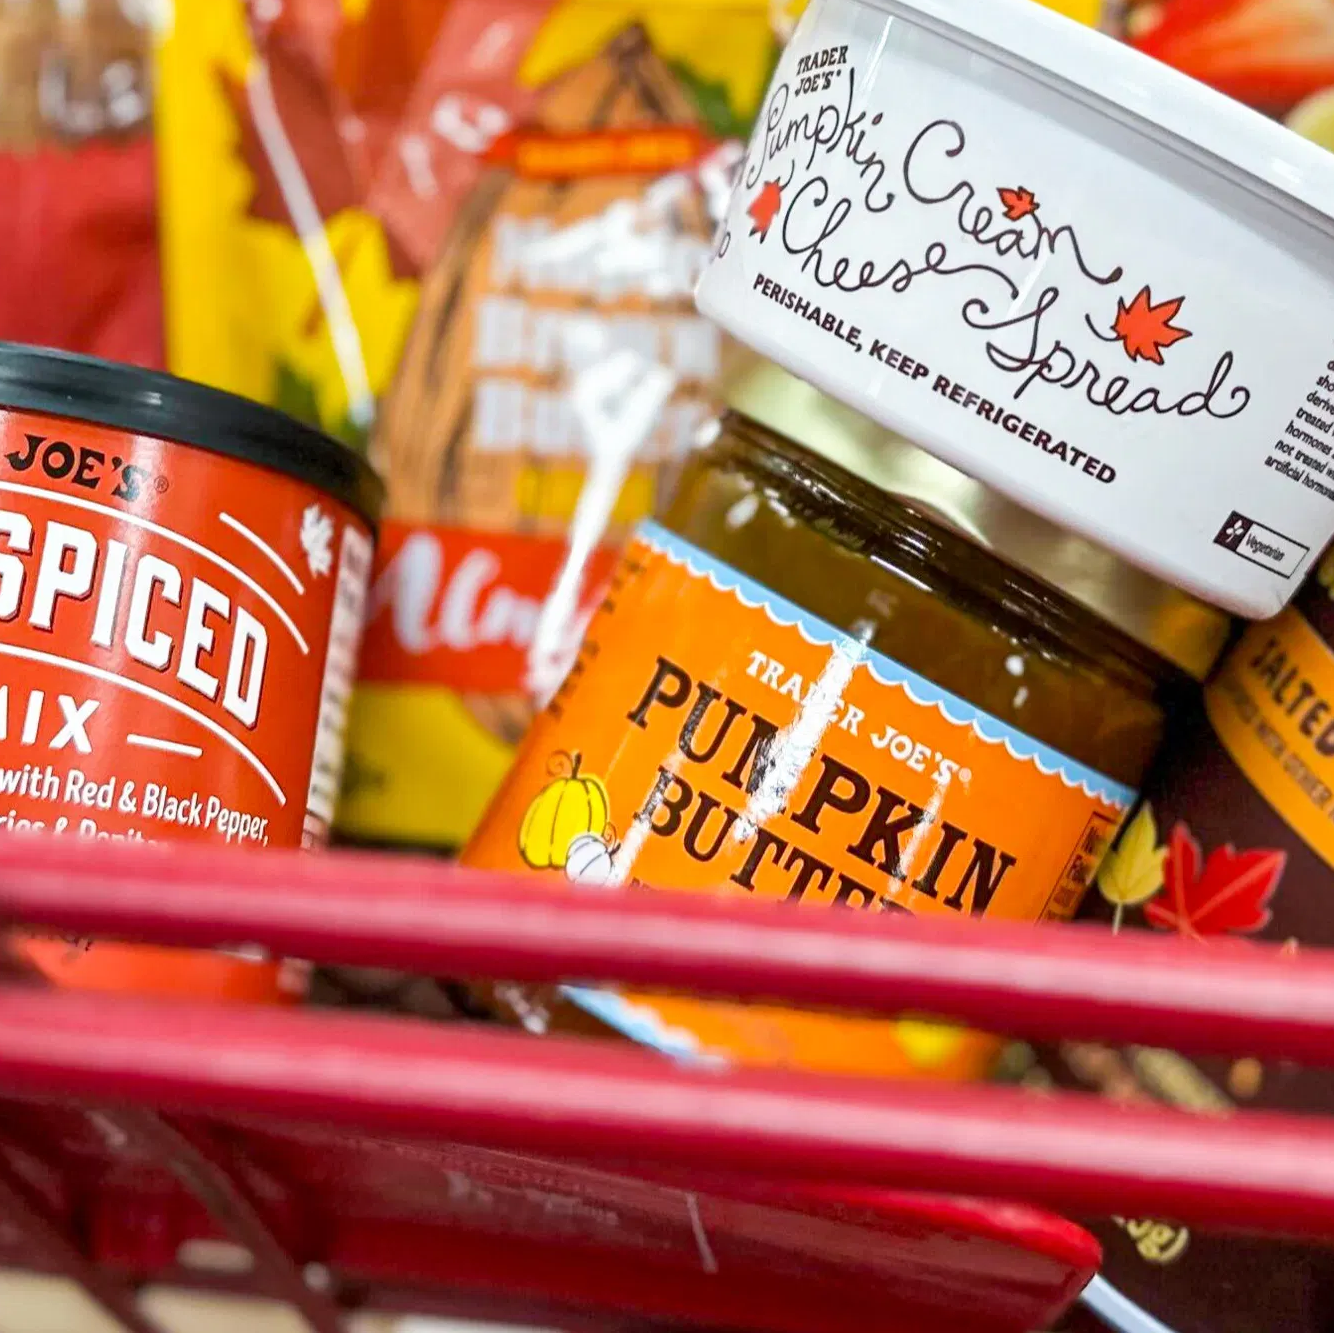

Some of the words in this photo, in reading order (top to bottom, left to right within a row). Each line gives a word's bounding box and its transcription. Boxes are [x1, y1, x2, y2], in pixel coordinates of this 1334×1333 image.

[793, 70, 835, 97] JOE'S
[795, 45, 849, 76] TRADER
[746, 67, 896, 213] Pumpkin
[902, 119, 1124, 285] Cream
[782, 175, 1019, 294] Cheese
[752, 272, 864, 353] PERISHABLE,
[868, 338, 930, 381] KEEP
[931, 375, 1118, 485] REFRIGERATED
[961, 286, 1251, 419] Spread
[1284, 419, 1333, 456] hormones
[1295, 407, 1334, 435] treated
[3, 433, 149, 502] JOE'S
[1264, 455, 1303, 483] artificial
[1274, 438, 1295, 457] not
[1294, 448, 1328, 475] treated
[745, 649, 867, 737] TRAR
[869, 724, 962, 788] JOE'S
[63, 767, 116, 811] Red
[117, 779, 138, 814] &
[140, 781, 203, 829] Black
[203, 797, 270, 848] Pepper,
